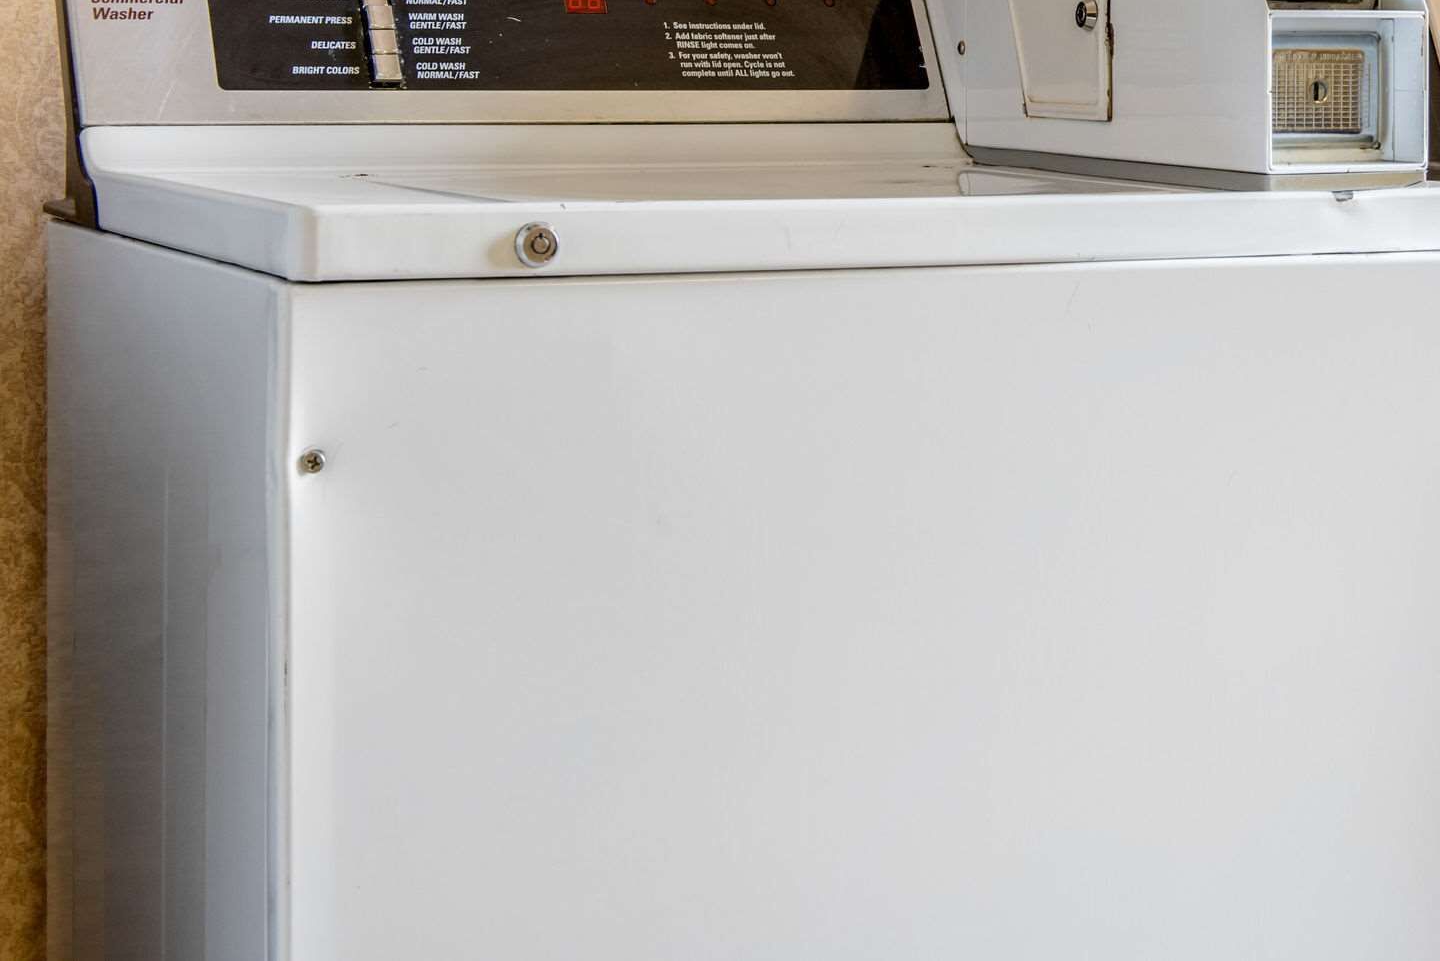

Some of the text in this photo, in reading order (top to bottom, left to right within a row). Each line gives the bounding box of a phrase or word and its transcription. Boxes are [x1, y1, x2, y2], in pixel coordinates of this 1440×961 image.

[93, 8, 154, 19] Washer
[269, 16, 323, 24] PERMANENT
[410, 22, 466, 30] GENTLE/FAST
[744, 33, 758, 41] just
[312, 41, 356, 49] DELICATES
[701, 42, 718, 50] light
[414, 46, 471, 54] GENTLE/FAST
[710, 52, 733, 60] safety,
[744, 61, 764, 69] Cycle
[293, 66, 325, 74] BRIGHT
[682, 70, 715, 78] complete
[750, 70, 769, 78] lights
[418, 71, 480, 79] NORMAL/FAST
